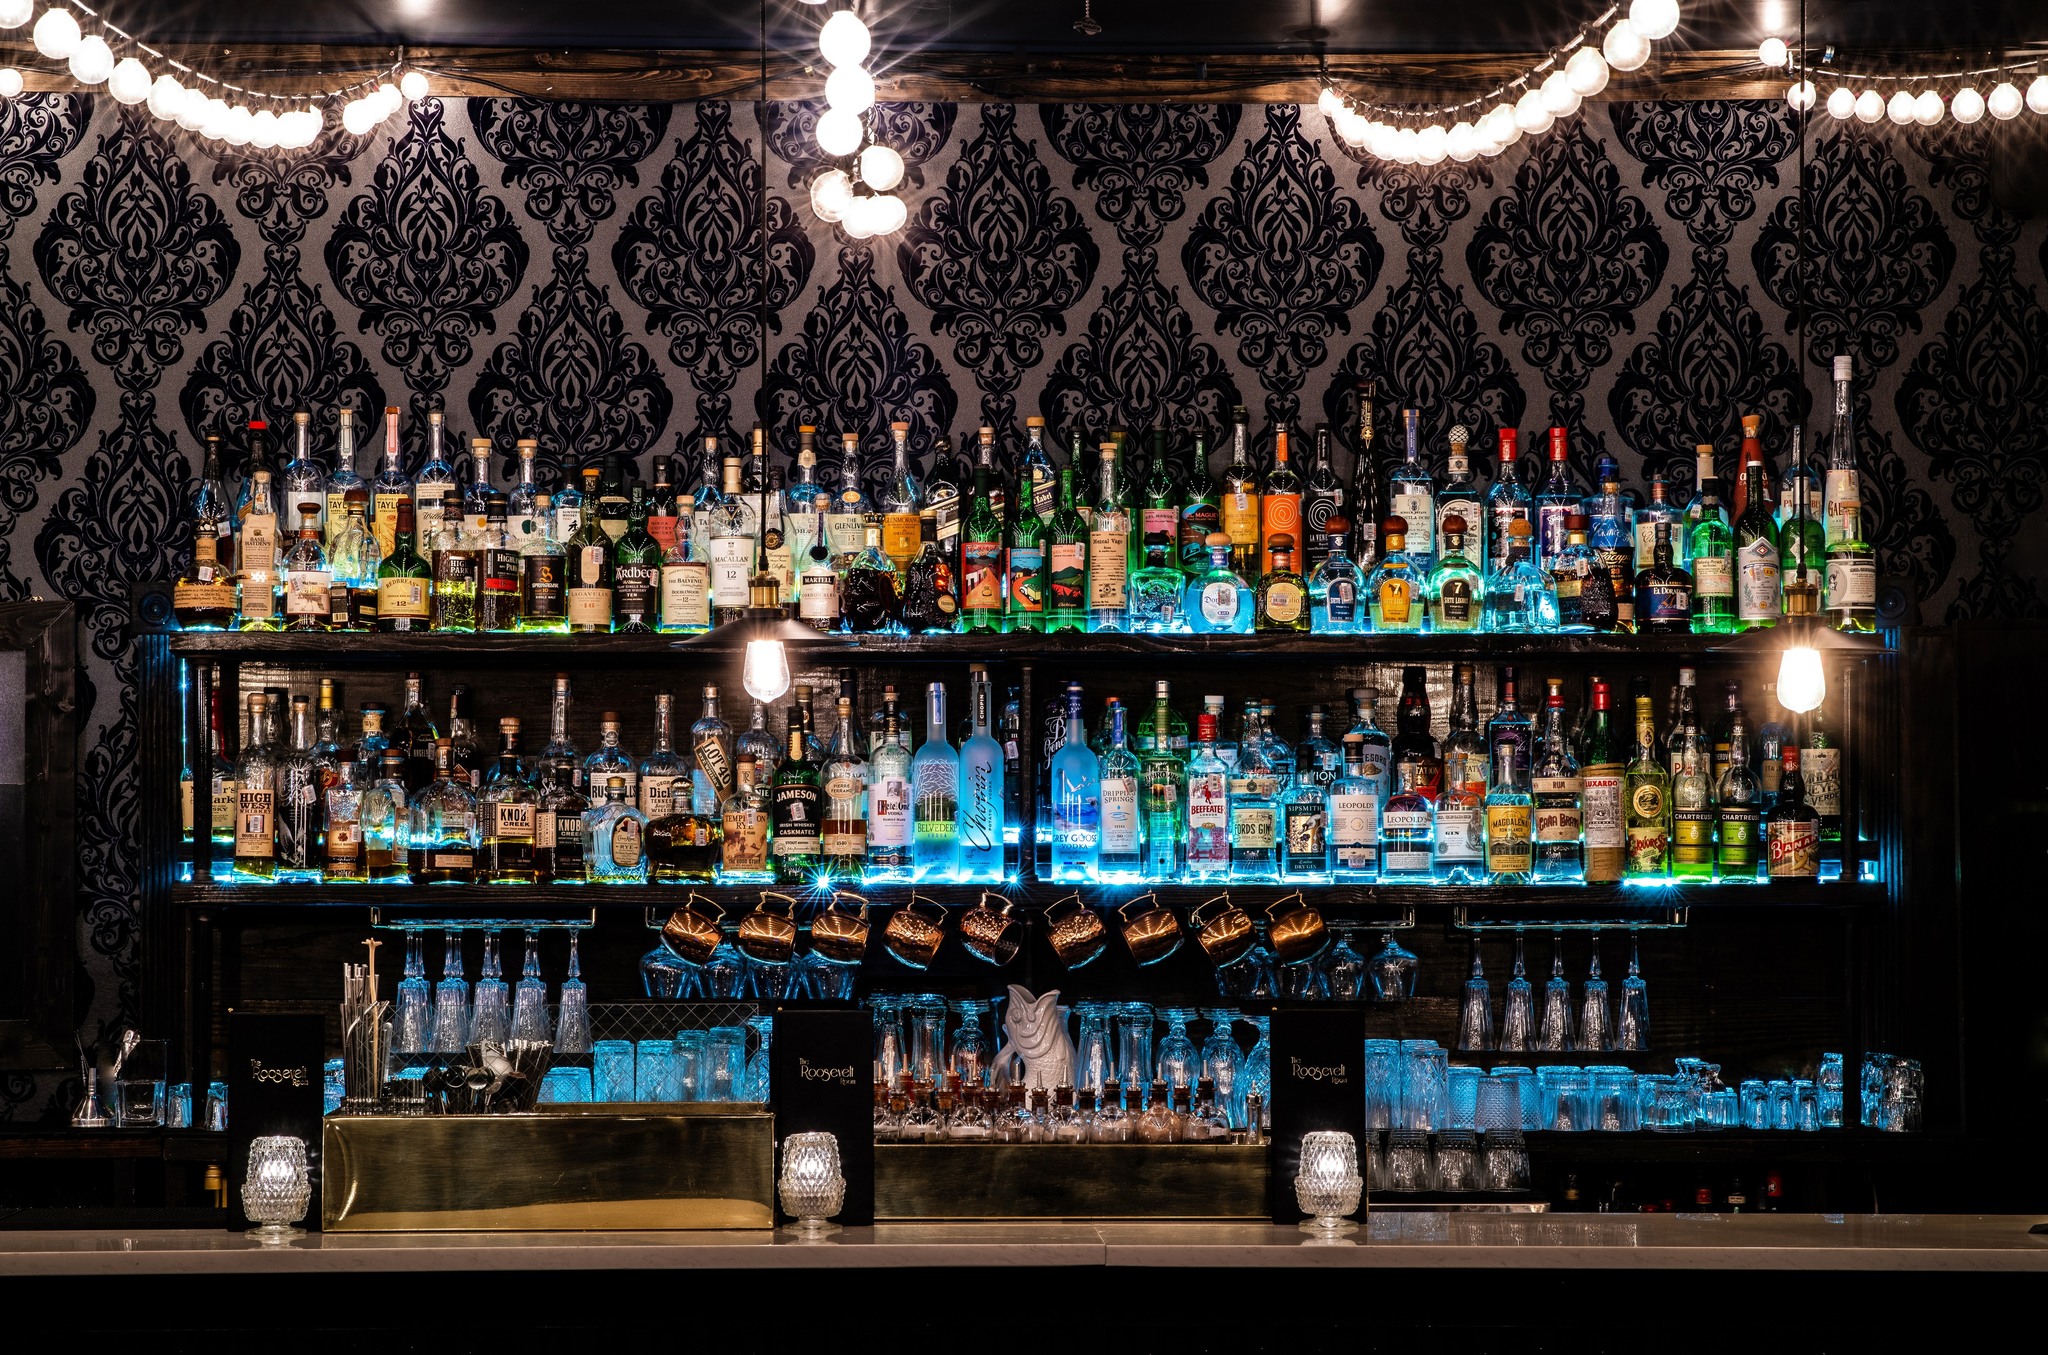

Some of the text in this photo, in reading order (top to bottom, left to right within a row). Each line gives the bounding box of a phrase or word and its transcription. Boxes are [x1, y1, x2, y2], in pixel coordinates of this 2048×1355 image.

[726, 570, 737, 578] 12
[1393, 584, 1400, 594] 7
[1455, 583, 1462, 594] 7
[702, 740, 731, 784] LOT 40
[1365, 754, 1386, 765] ESORO
[592, 785, 636, 798] RUSLL'S
[776, 790, 817, 802] JAMESON
[240, 793, 271, 802] HIGH
[1811, 793, 1840, 805] VERDE
[898, 802, 910, 811] One
[963, 760, 998, 851] Chopin
[501, 809, 526, 821] KNOB
[559, 819, 580, 831] KNOB
[918, 822, 958, 833] BELVEDERE
[1492, 818, 1528, 827] MAGDALENA
[1234, 824, 1270, 834] FORDS GIN
[1053, 833, 1098, 843] GREY GOOSE
[1771, 835, 1818, 859] BANAN
[801, 1065, 854, 1082] Roosevelt
[1292, 1064, 1346, 1080] Roosevelt
